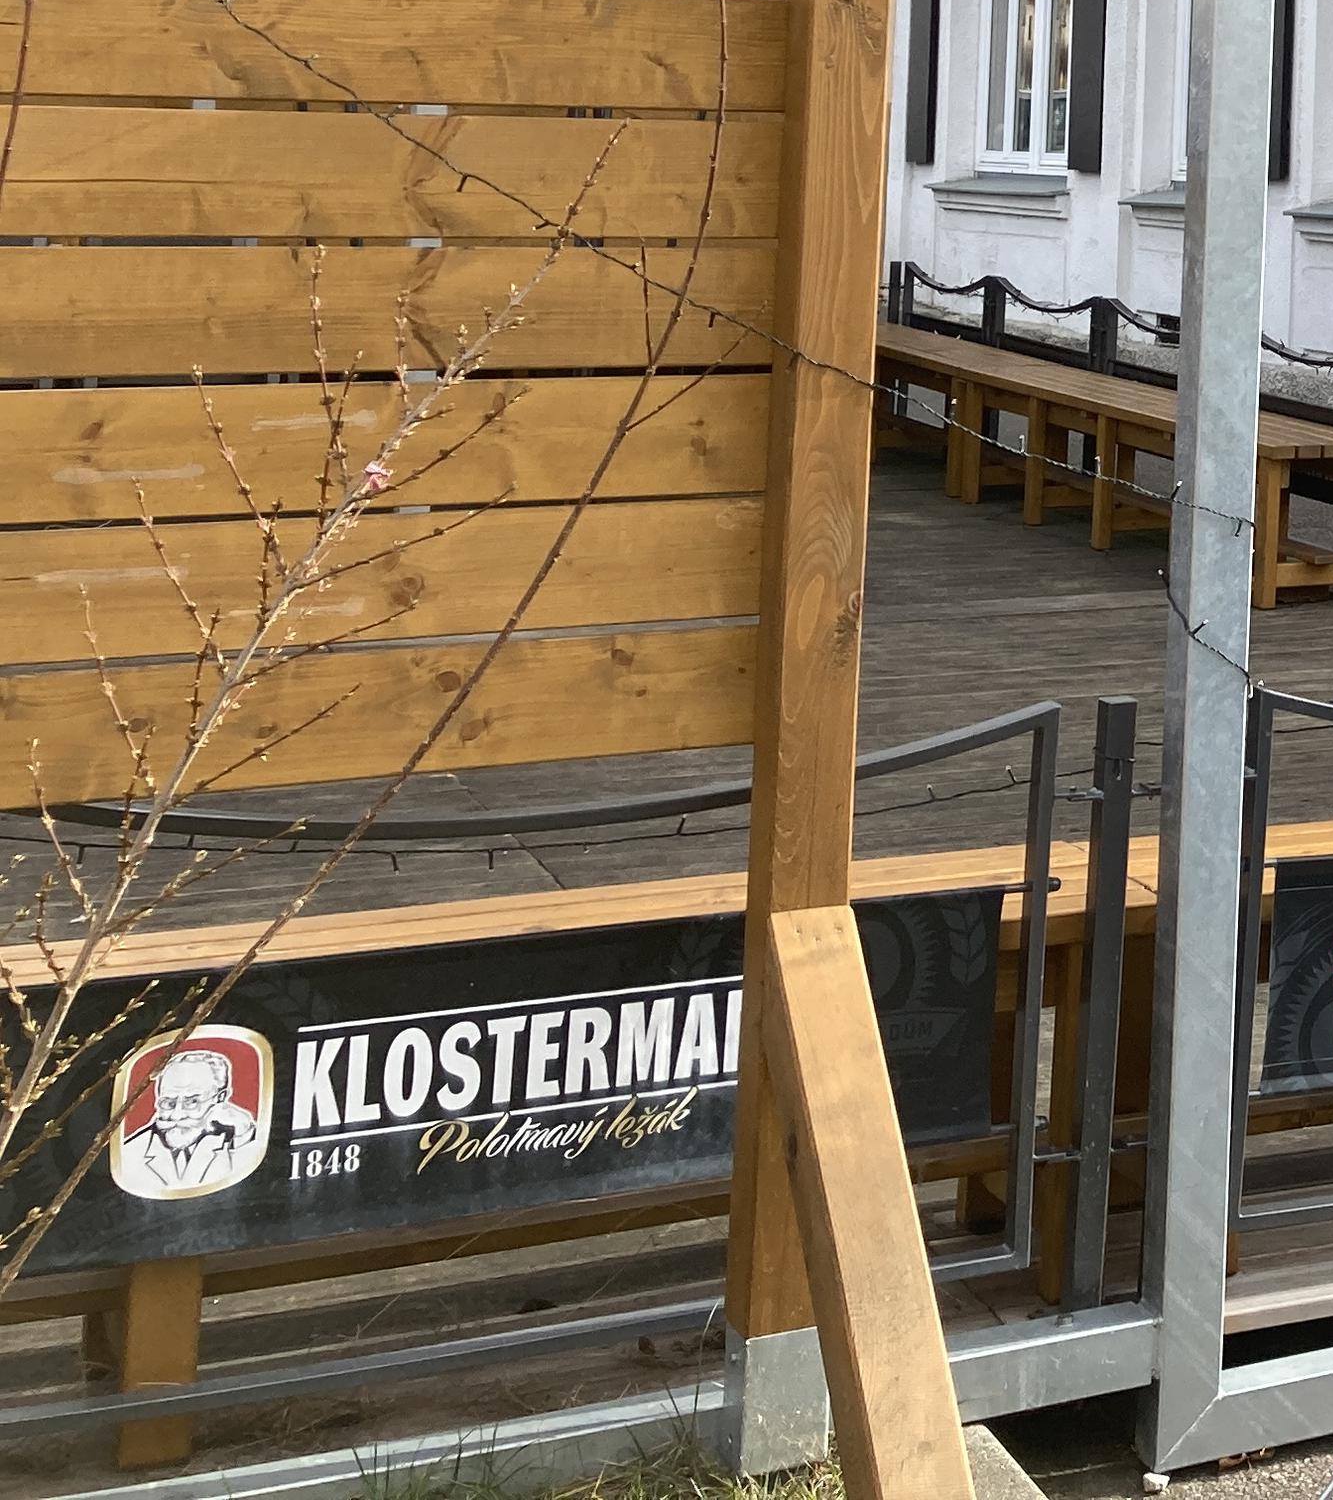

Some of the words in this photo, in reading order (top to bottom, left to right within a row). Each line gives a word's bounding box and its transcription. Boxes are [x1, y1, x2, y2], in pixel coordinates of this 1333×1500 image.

[291, 989, 743, 1132] KLOSTERMA
[288, 1143, 362, 1181] 1848
[416, 1108, 608, 1176] Polotmavý
[604, 1086, 698, 1147] ležák
